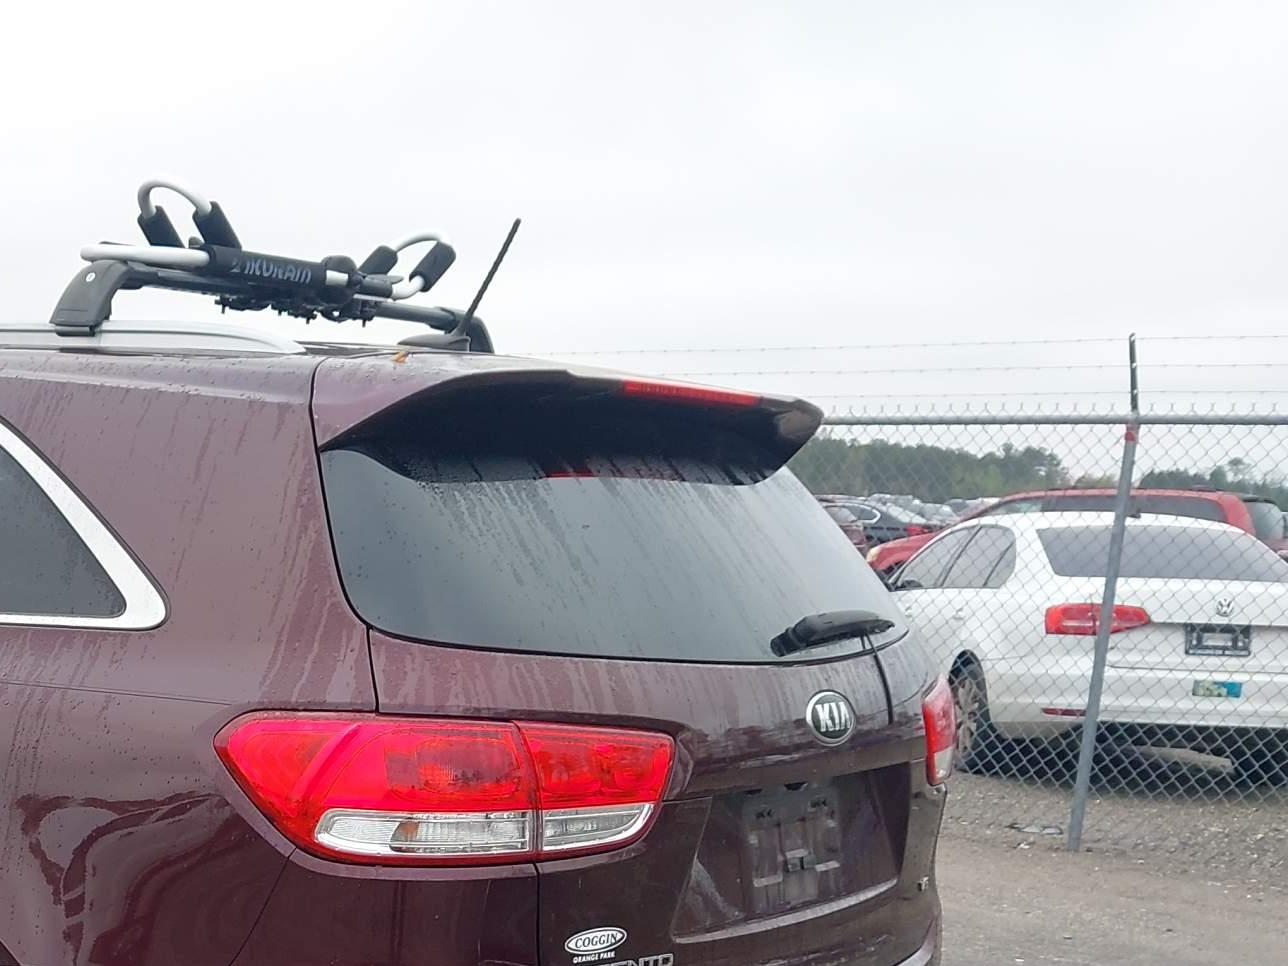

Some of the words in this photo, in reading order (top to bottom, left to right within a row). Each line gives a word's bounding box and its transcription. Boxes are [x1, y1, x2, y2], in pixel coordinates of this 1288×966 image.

[815, 701, 851, 732] KIA
[574, 932, 618, 949] COGGIN
[573, 953, 600, 964] ORANGE
[600, 950, 616, 960] PARK
